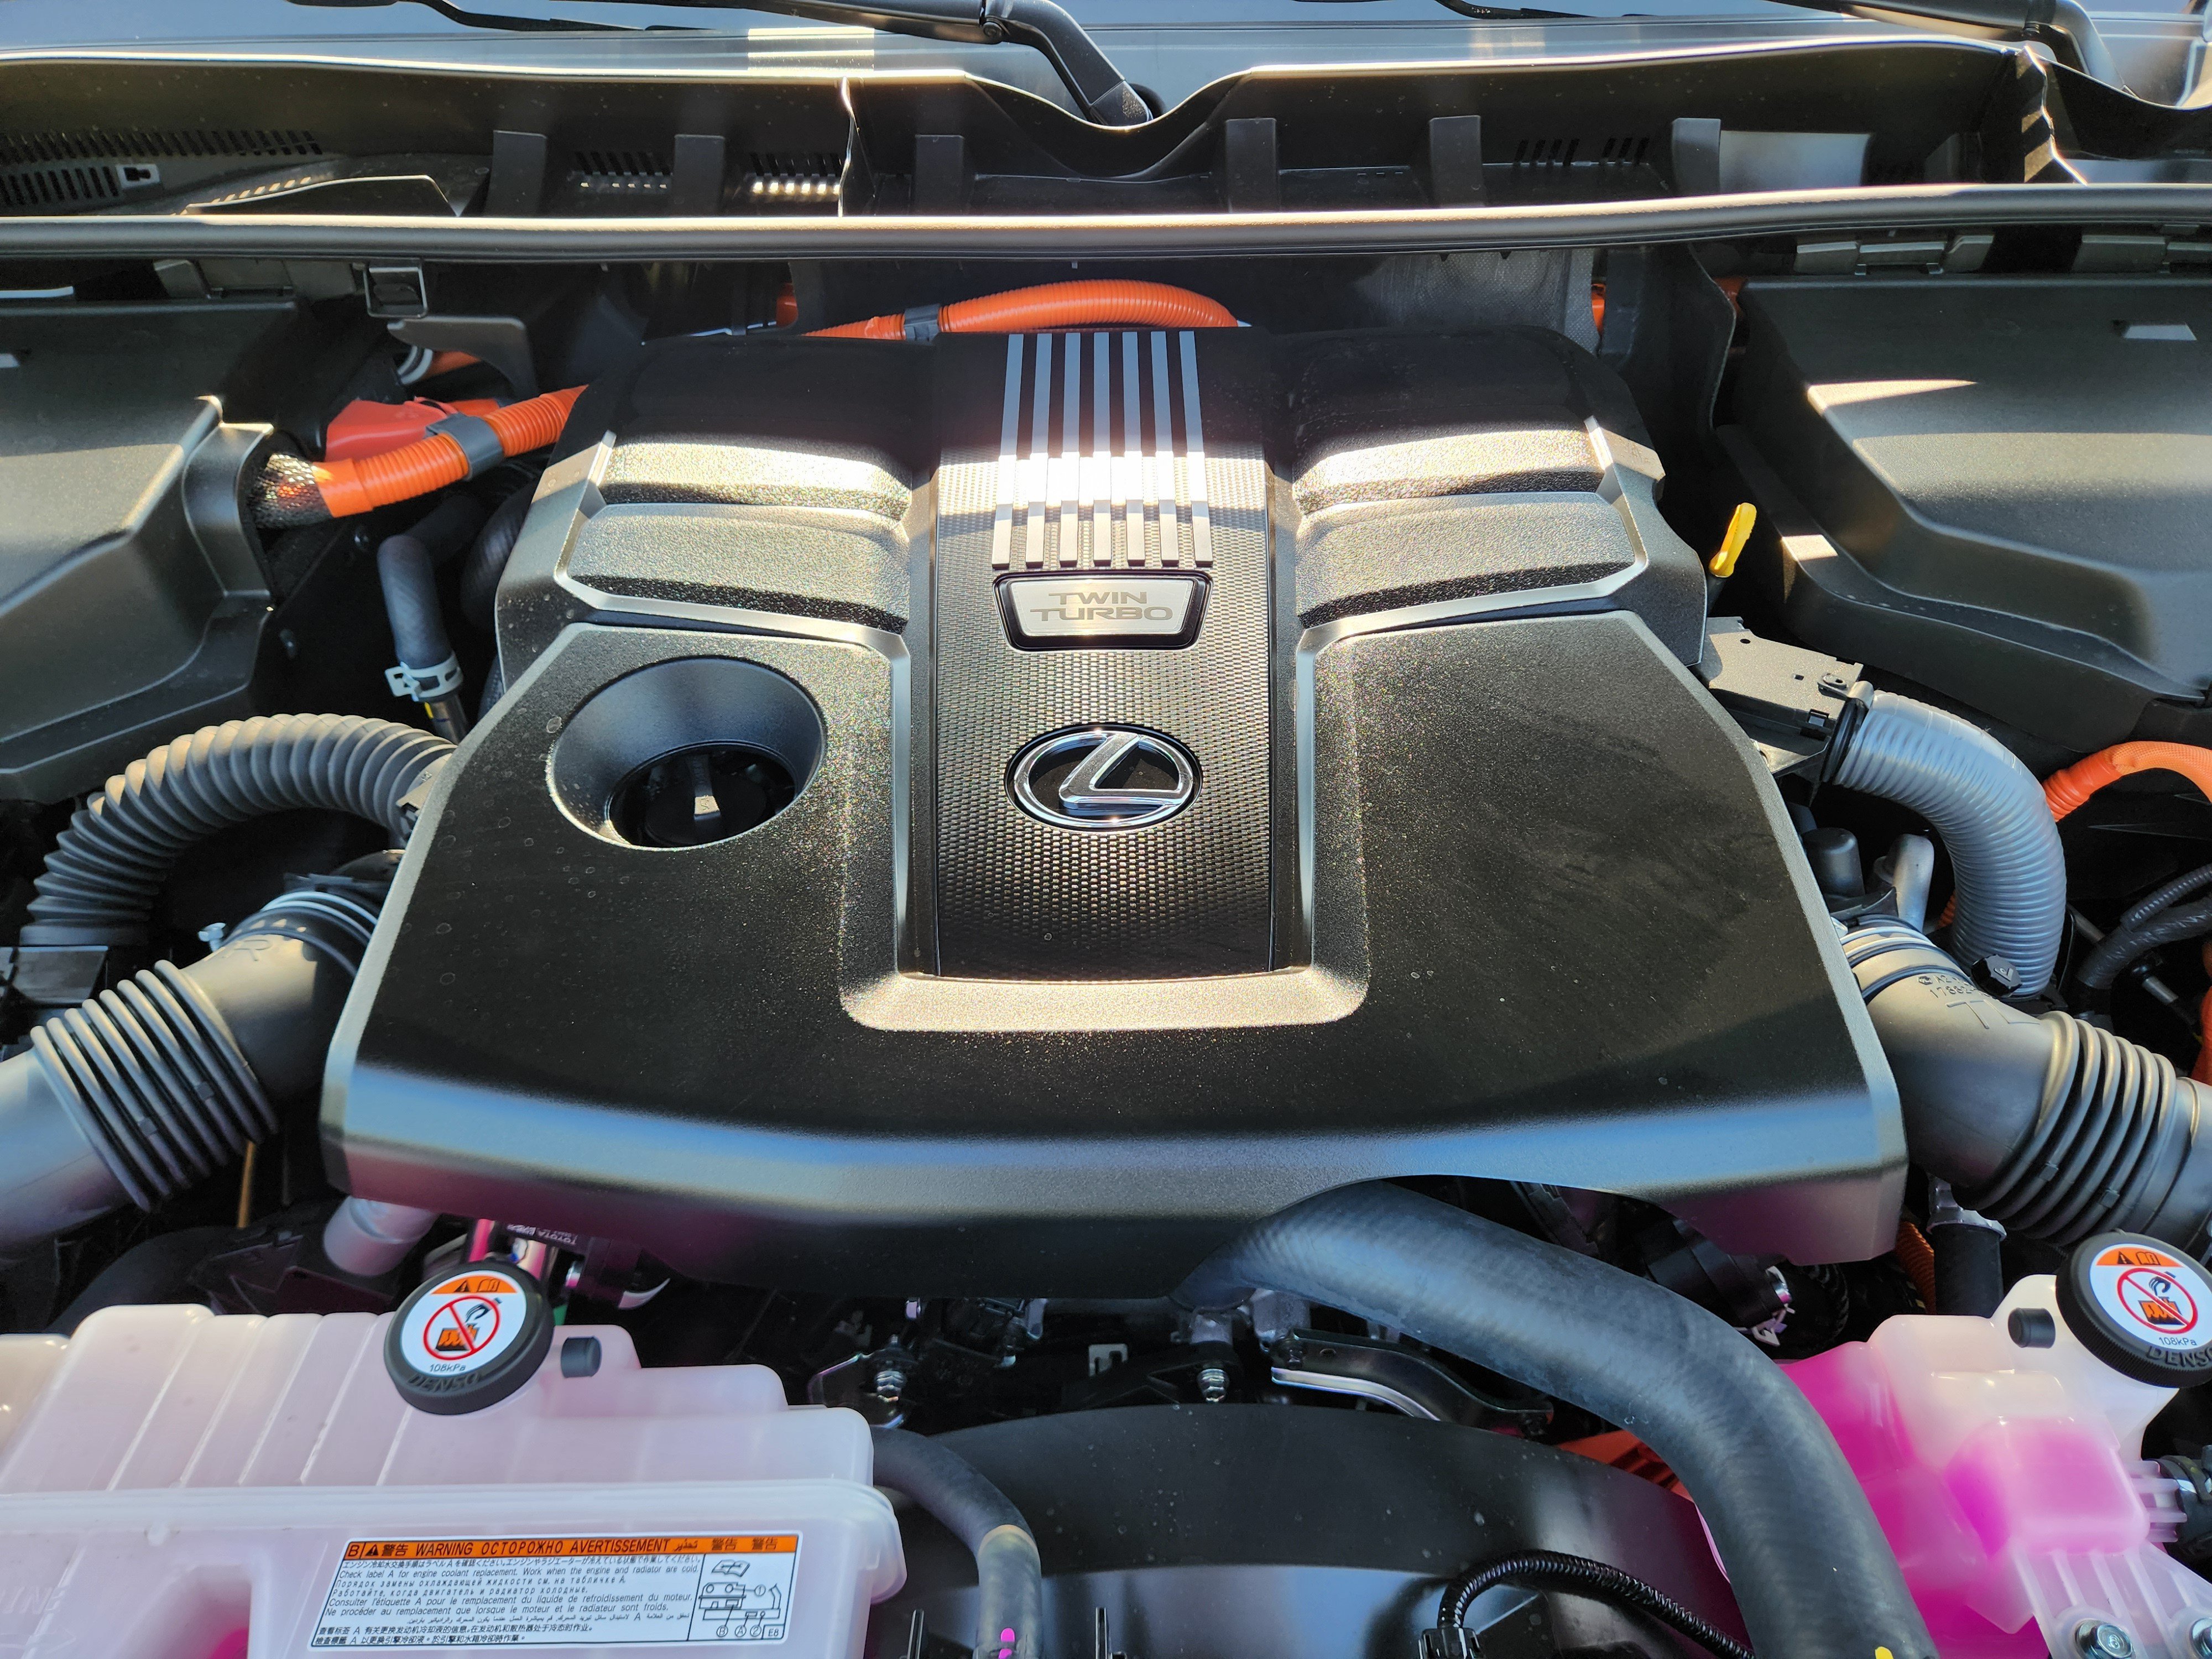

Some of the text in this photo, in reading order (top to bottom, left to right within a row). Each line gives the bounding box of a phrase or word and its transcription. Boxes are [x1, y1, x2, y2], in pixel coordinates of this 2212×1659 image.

[1048, 592, 1147, 605] TWIN
[1030, 606, 1173, 622] TURBO
[2158, 1336, 2198, 1347] 108kPa
[430, 1363, 467, 1372] 108kPa
[407, 1371, 482, 1393] DENSO
[349, 1544, 360, 1557] B
[382, 1543, 409, 1557] 警告
[416, 1542, 473, 1556] WARNING
[481, 1541, 563, 1555] ОСТОРОЖНО
[570, 1539, 670, 1553] AVERTISSEMENT
[413, 1569, 437, 1578] engine
[473, 1569, 517, 1577] replacement.
[682, 1565, 699, 1573] cold.
[329, 1598, 368, 1606] Consulter
[415, 1597, 421, 1605] A
[462, 1597, 517, 1605] remplacement
[521, 1595, 532, 1604] du
[536, 1595, 563, 1604] liquide
[582, 1594, 643, 1603] refroidissement
[648, 1593, 659, 1601] du
[341, 1607, 377, 1616] procéder
[396, 1607, 451, 1615] remplacement
[476, 1606, 505, 1615] lorsque
[579, 1604, 616, 1612] radiateur
[644, 1603, 668, 1611] froids.
[353, 1626, 360, 1635] A
[768, 1628, 779, 1637] E8
